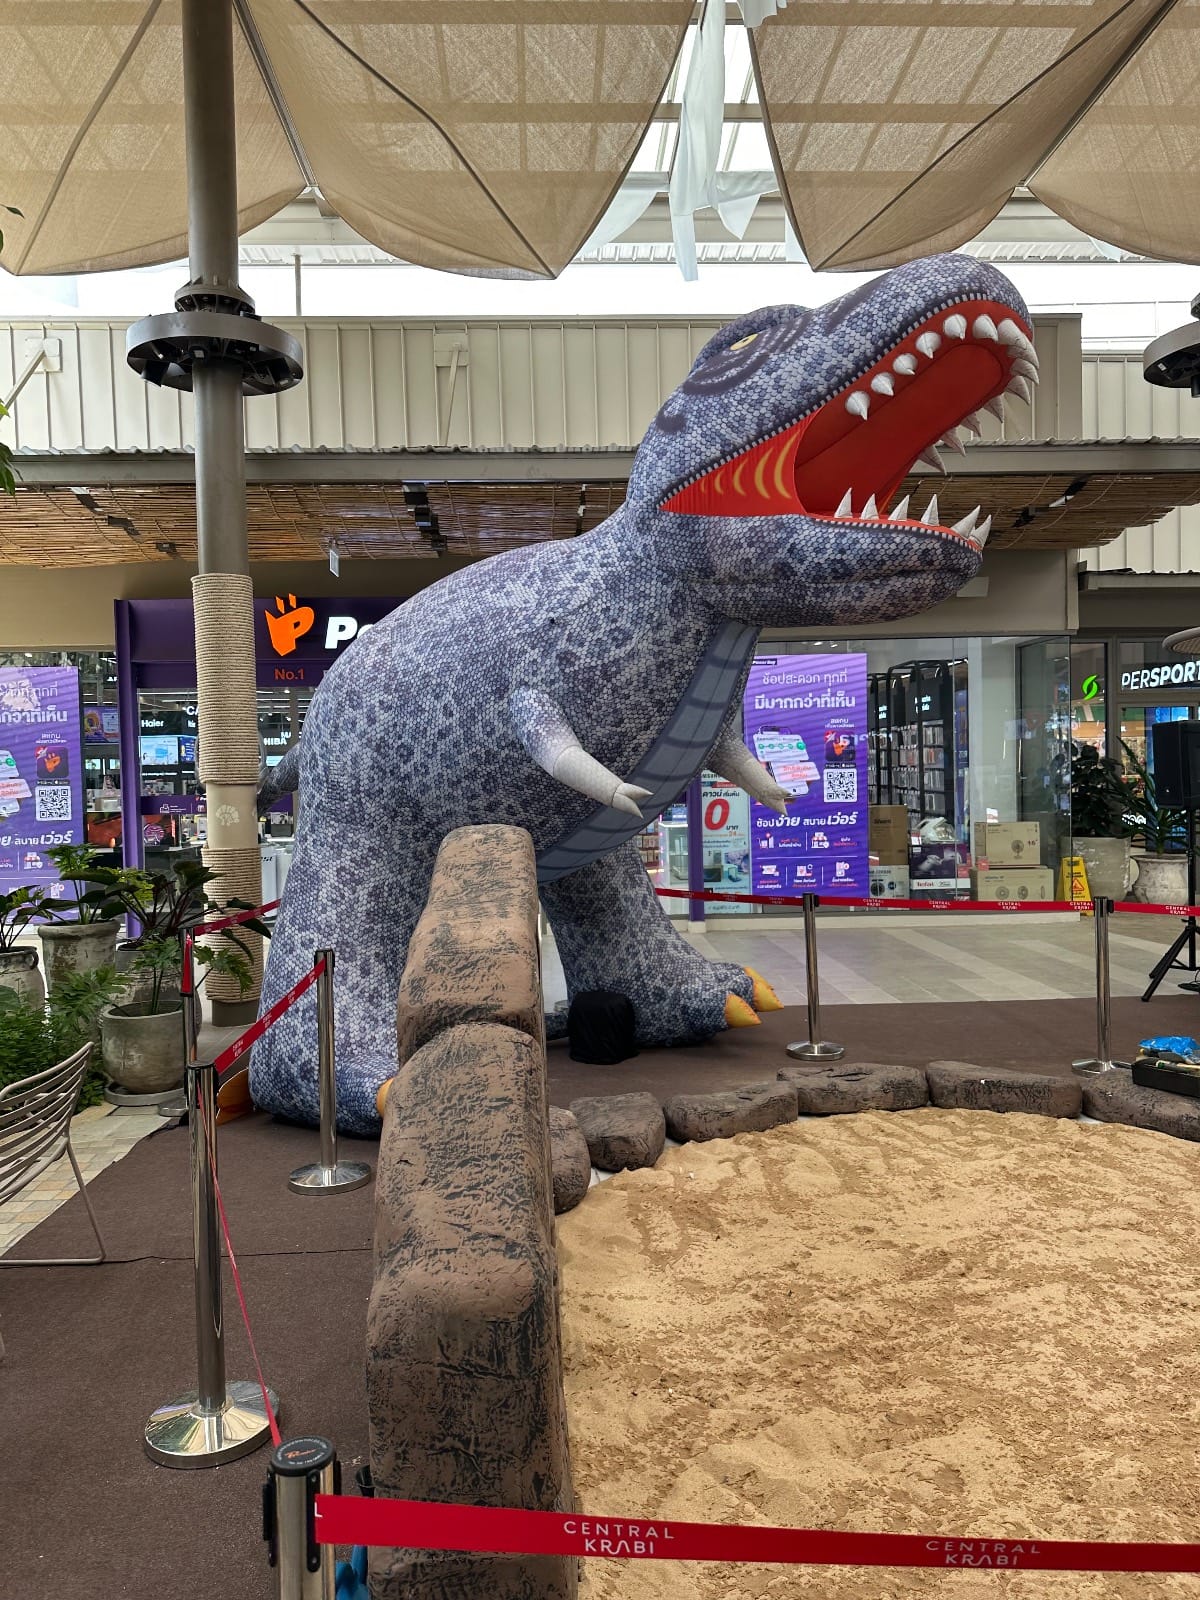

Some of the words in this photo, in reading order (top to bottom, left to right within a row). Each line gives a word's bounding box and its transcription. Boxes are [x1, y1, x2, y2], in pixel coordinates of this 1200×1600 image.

[274, 668, 304, 680] No.1
[141, 719, 164, 728] Haier
[704, 798, 730, 831] 0
[563, 1520, 675, 1539] CENTRAL
[585, 1538, 654, 1555] KRABI
[926, 1540, 1041, 1554] CENTRAL
[945, 1553, 1018, 1566] KRABI
